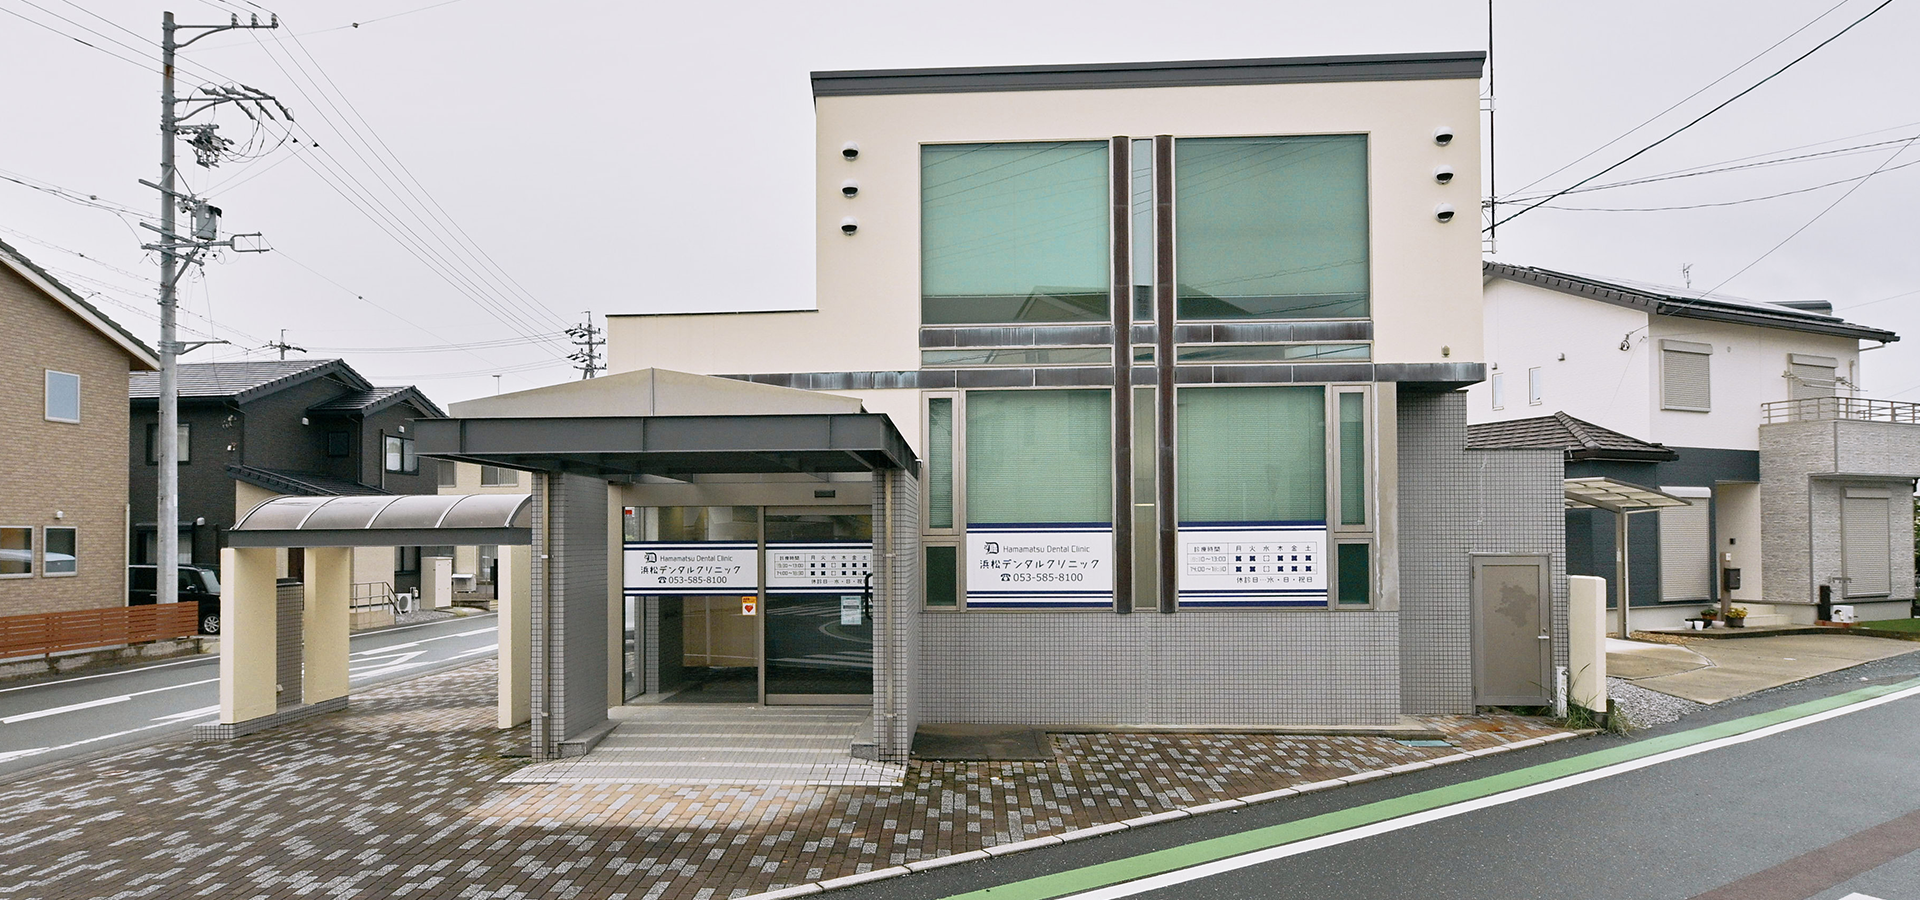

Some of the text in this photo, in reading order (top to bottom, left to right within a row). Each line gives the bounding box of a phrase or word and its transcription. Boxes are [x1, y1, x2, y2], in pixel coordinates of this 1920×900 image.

[1003, 545, 1090, 553] Hamamatsu Dental Clinic
[696, 554, 716, 562] Dental
[717, 554, 733, 562] Clinic
[979, 558, 1100, 569] 浜松デンタルクリニック
[640, 565, 741, 574] 浜松デンタルクリニック
[668, 576, 728, 584] 053-585-8100
[1013, 572, 1084, 582] 053-585-8100
